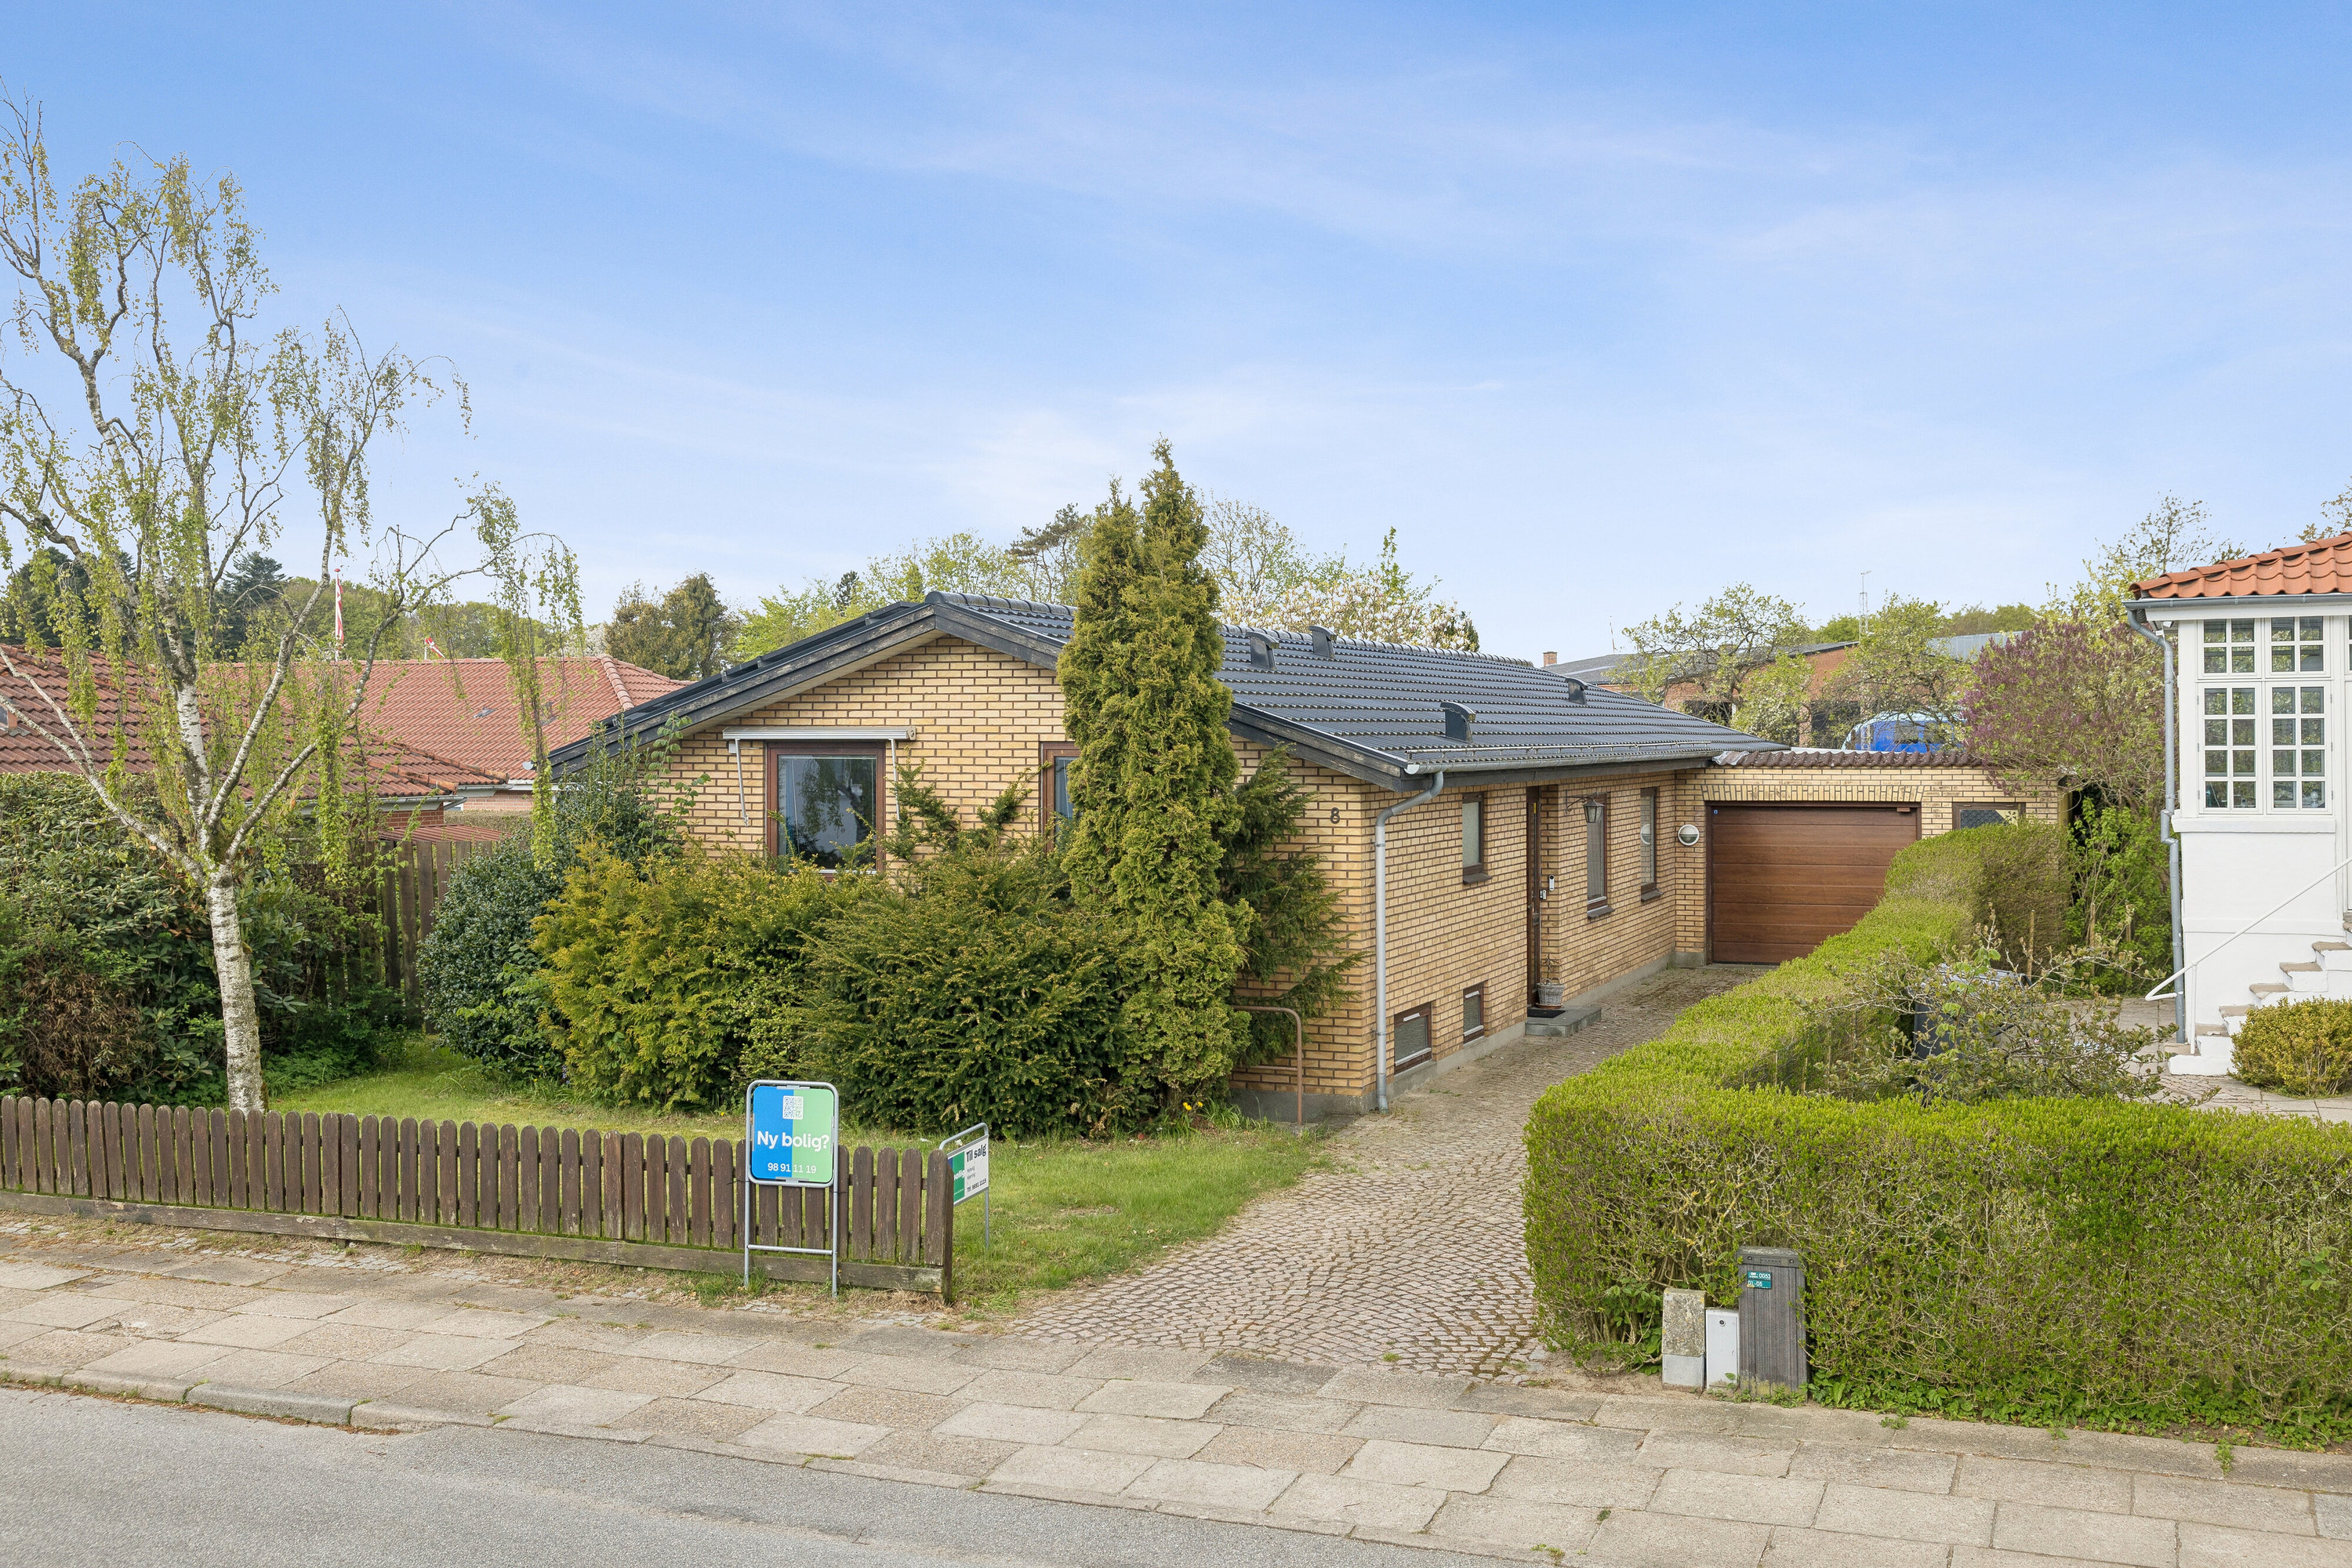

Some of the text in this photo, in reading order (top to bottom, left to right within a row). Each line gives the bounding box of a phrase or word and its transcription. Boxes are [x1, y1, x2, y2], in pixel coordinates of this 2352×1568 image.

[1330, 808, 1340, 824] 8
[757, 1131, 829, 1152] Ny bolig?
[974, 1144, 986, 1158] salg
[768, 1163, 816, 1174] 98 91 11 19
